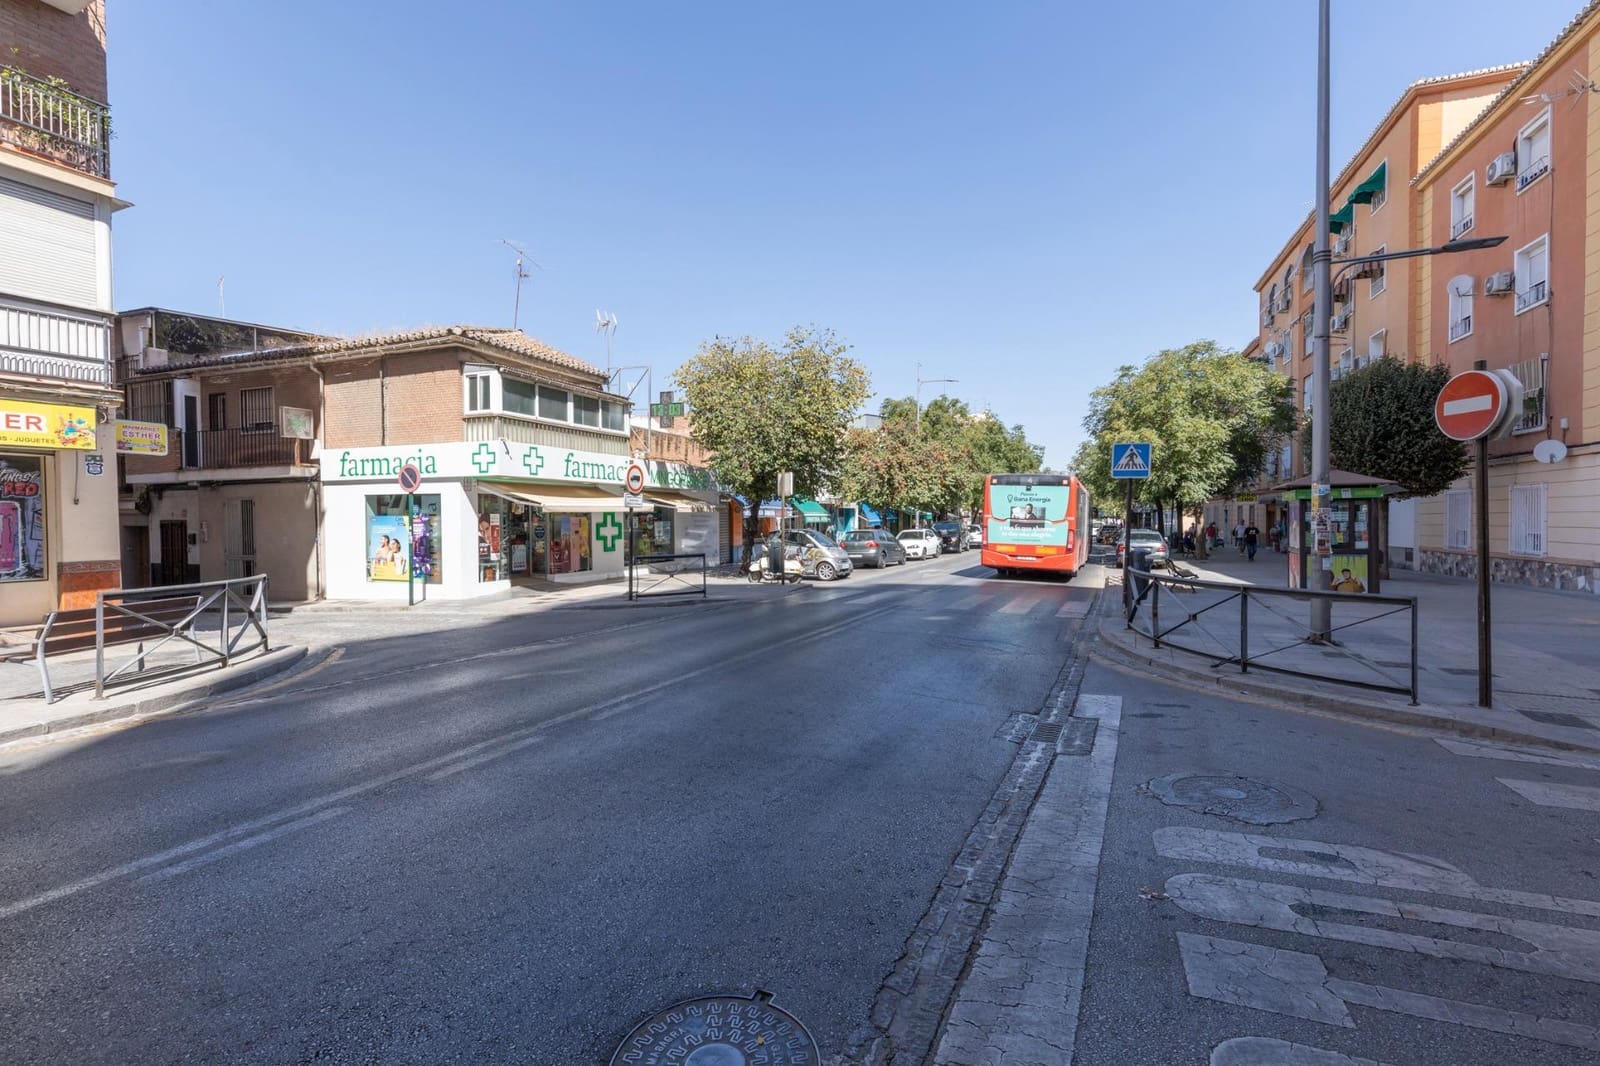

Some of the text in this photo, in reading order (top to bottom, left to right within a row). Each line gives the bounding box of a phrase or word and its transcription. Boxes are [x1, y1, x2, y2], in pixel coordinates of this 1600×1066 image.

[14, 436, 56, 444] JUGUETES
[122, 431, 161, 440] ESTHER
[564, 452, 628, 482] farmac
[3, 482, 38, 496] RED
